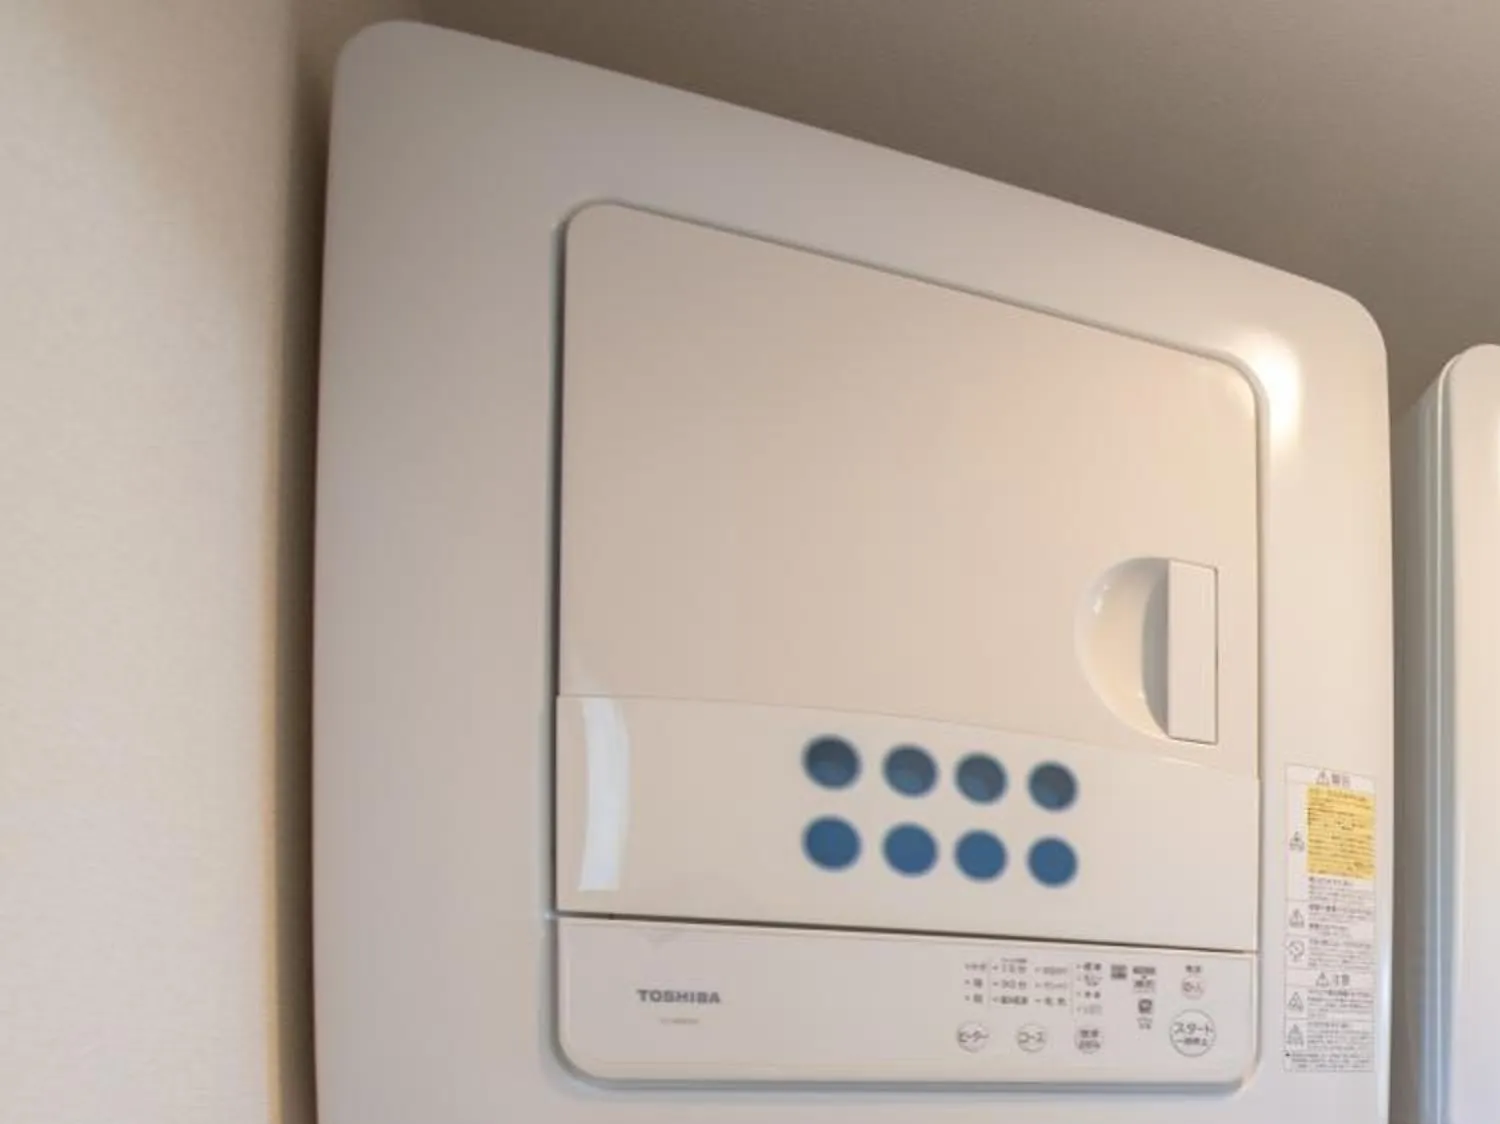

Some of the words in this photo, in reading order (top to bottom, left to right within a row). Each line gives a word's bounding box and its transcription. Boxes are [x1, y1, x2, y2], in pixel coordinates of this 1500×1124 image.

[636, 989, 722, 1004] TOSHIBA
[1173, 1021, 1214, 1036] スタート
